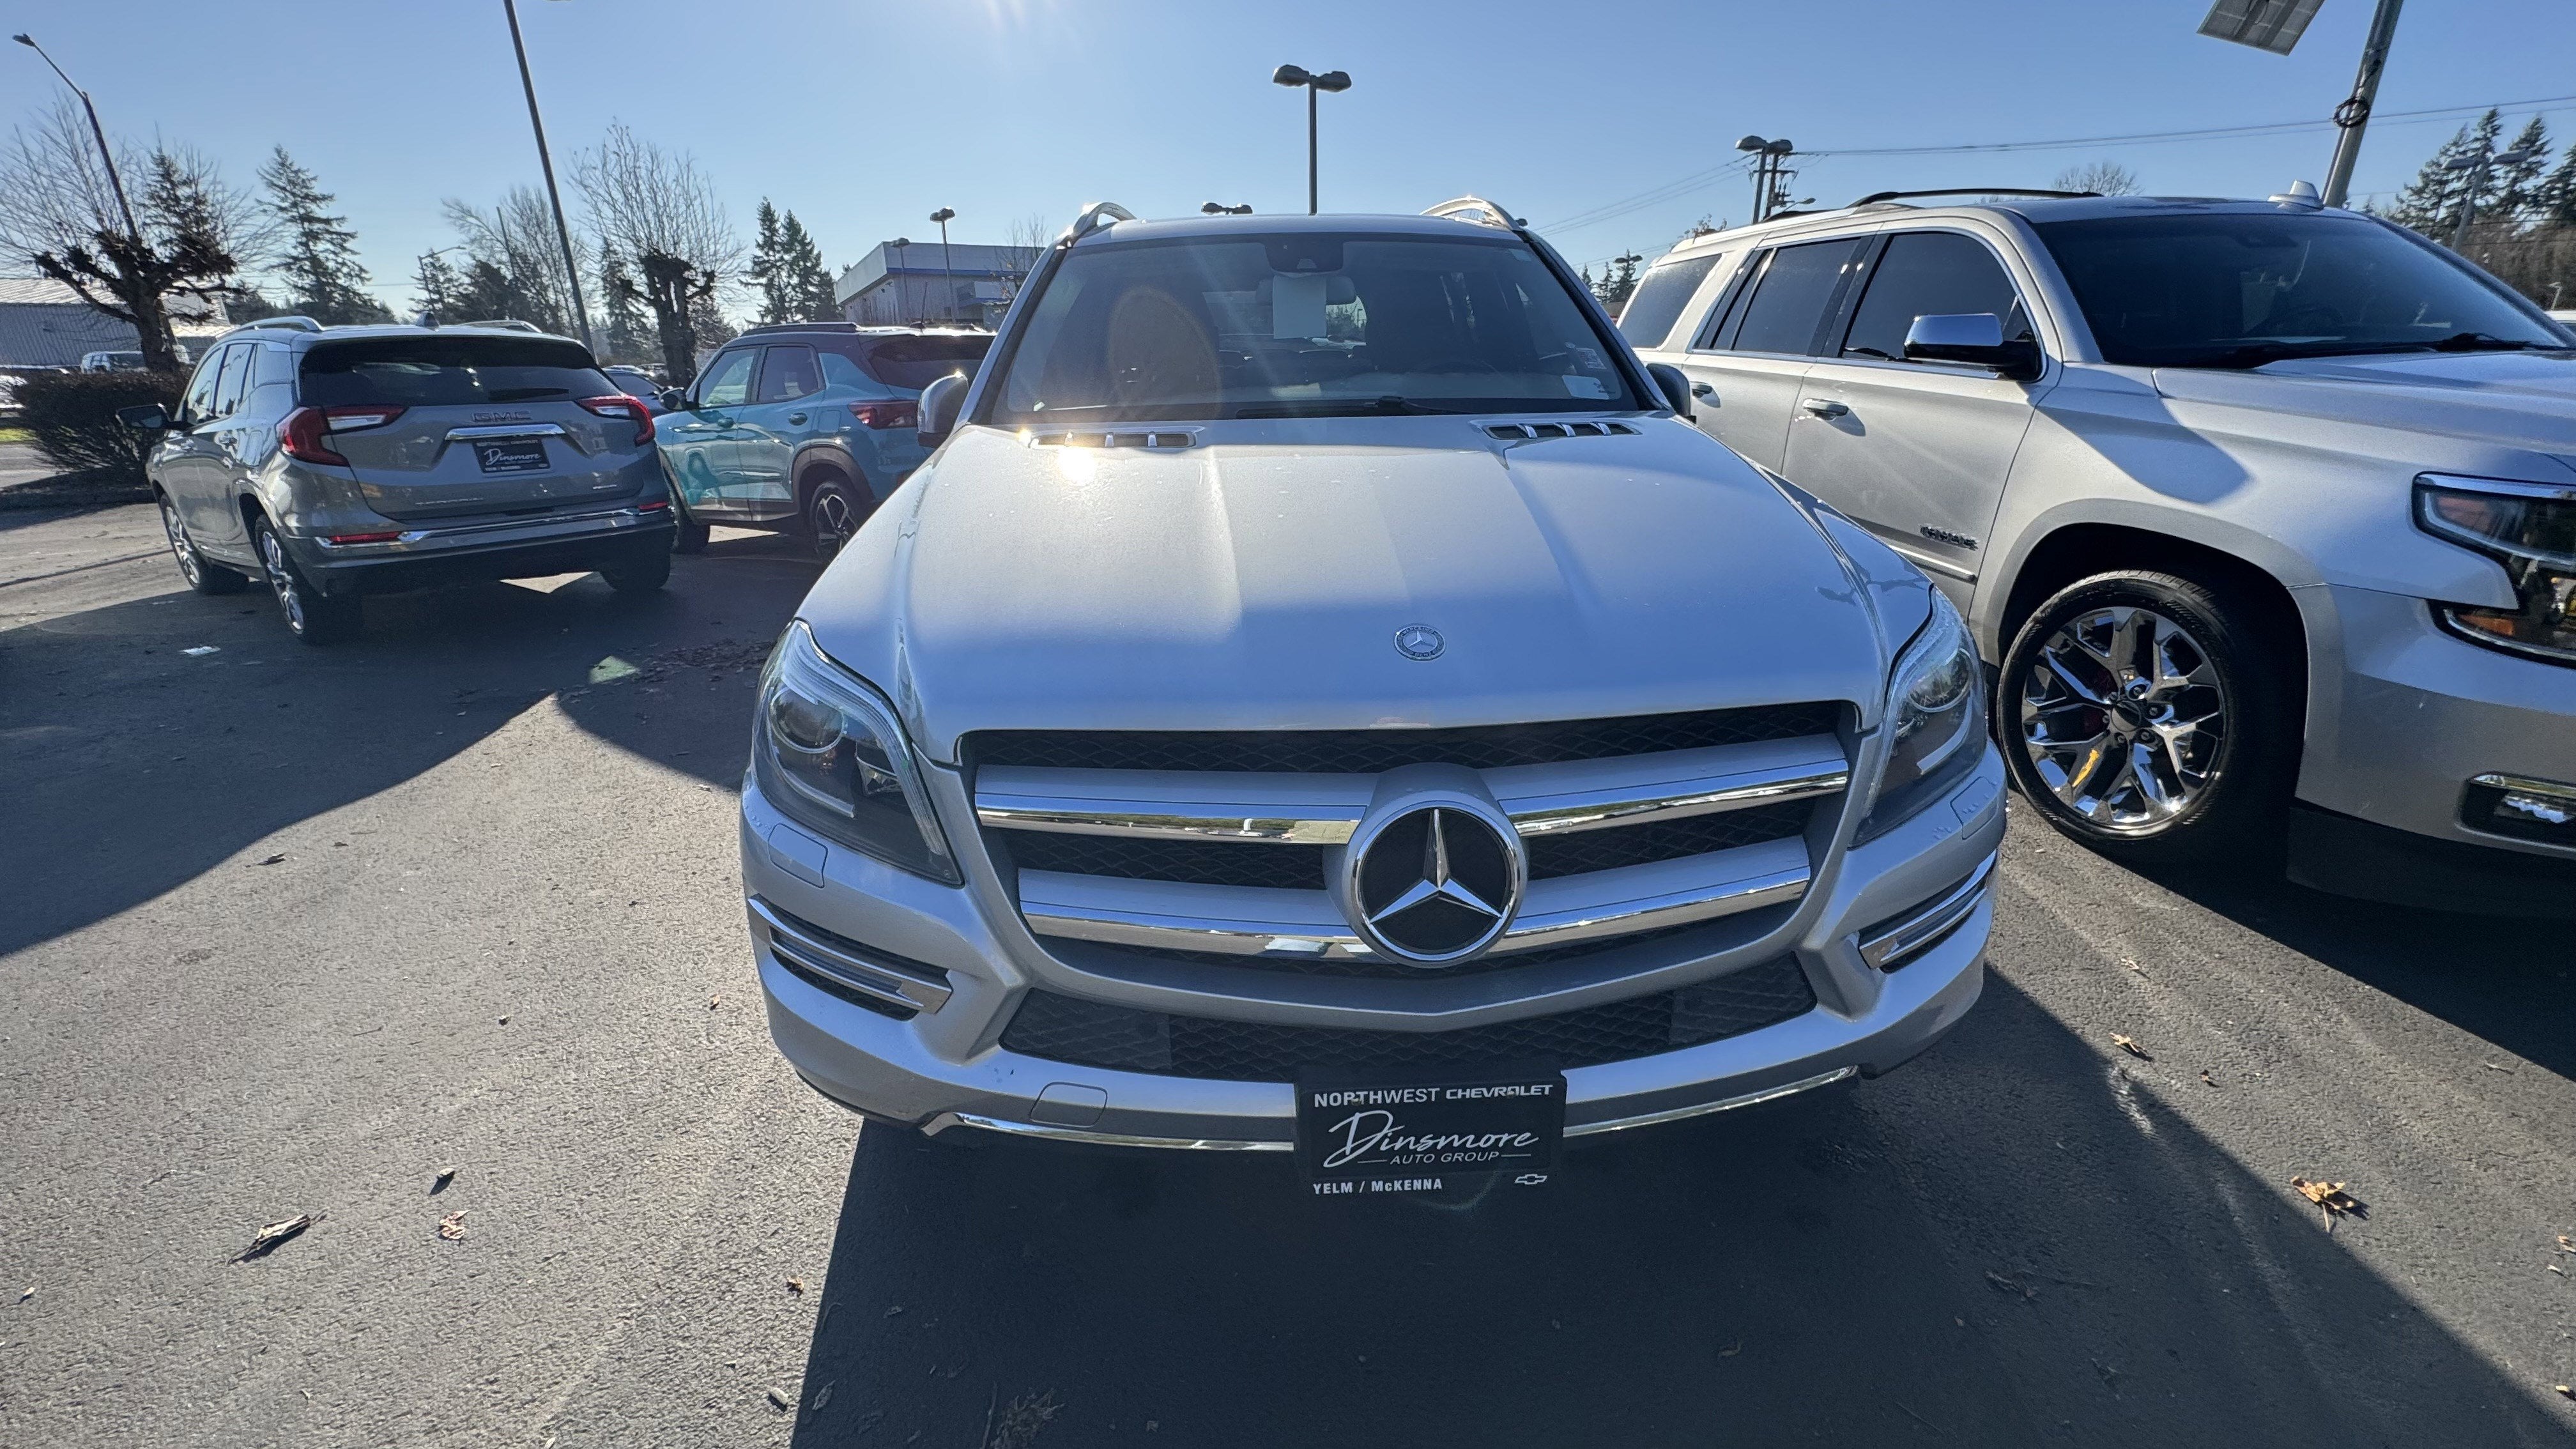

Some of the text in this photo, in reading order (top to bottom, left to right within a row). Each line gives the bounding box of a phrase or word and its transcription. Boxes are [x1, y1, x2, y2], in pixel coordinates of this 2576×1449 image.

[472, 411, 532, 422] GMC
[1314, 1084, 1553, 1108] NORTHWEST CHEVROLET
[1322, 1110, 1539, 1168] Dinsmore
[1390, 1151, 1499, 1165] AUTO GROUP
[1313, 1183, 1353, 1195] YELM
